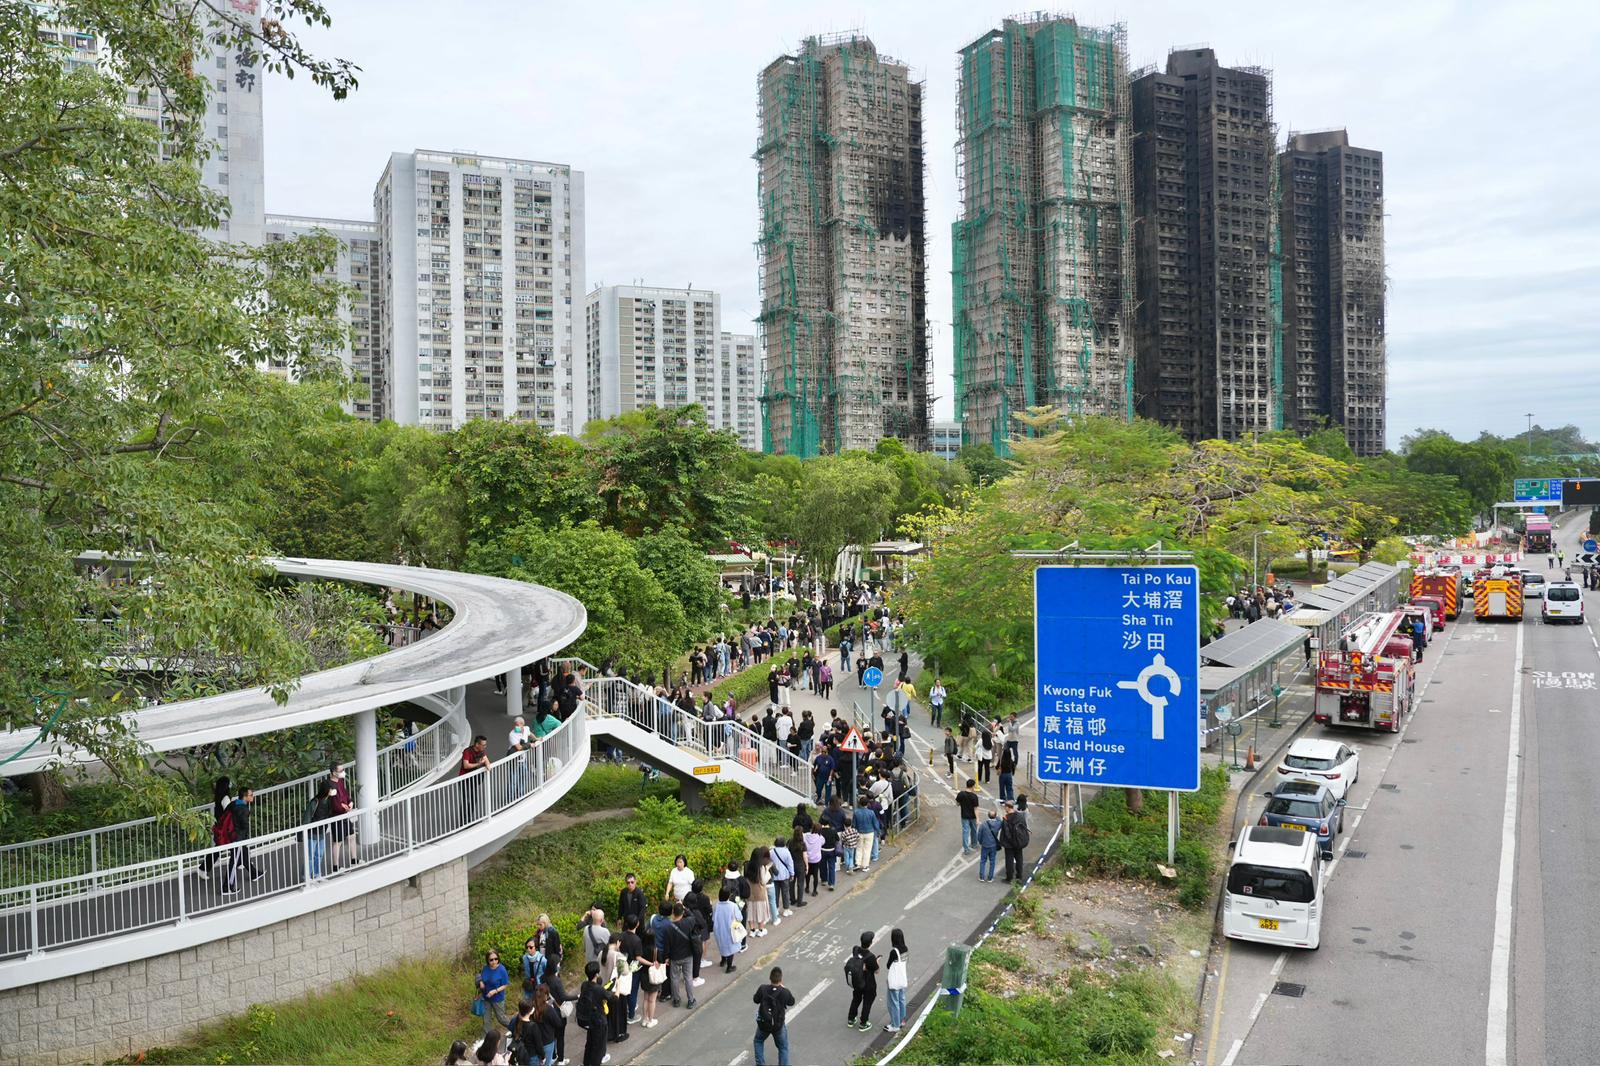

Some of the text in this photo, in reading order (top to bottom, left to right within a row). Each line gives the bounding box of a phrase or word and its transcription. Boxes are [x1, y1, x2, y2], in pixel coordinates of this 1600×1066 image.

[1121, 573, 1191, 585] Tai Po Kau
[1122, 590, 1183, 609] 大埔滘
[1122, 614, 1173, 626] Sha Tin
[1122, 631, 1165, 651] 沙田
[1043, 684, 1112, 699] Kwong Fuk
[1055, 700, 1096, 713] Estate
[1043, 715, 1106, 736] 廣福邨
[1043, 738, 1125, 753] Island House
[1044, 755, 1107, 776] 元洲仔
